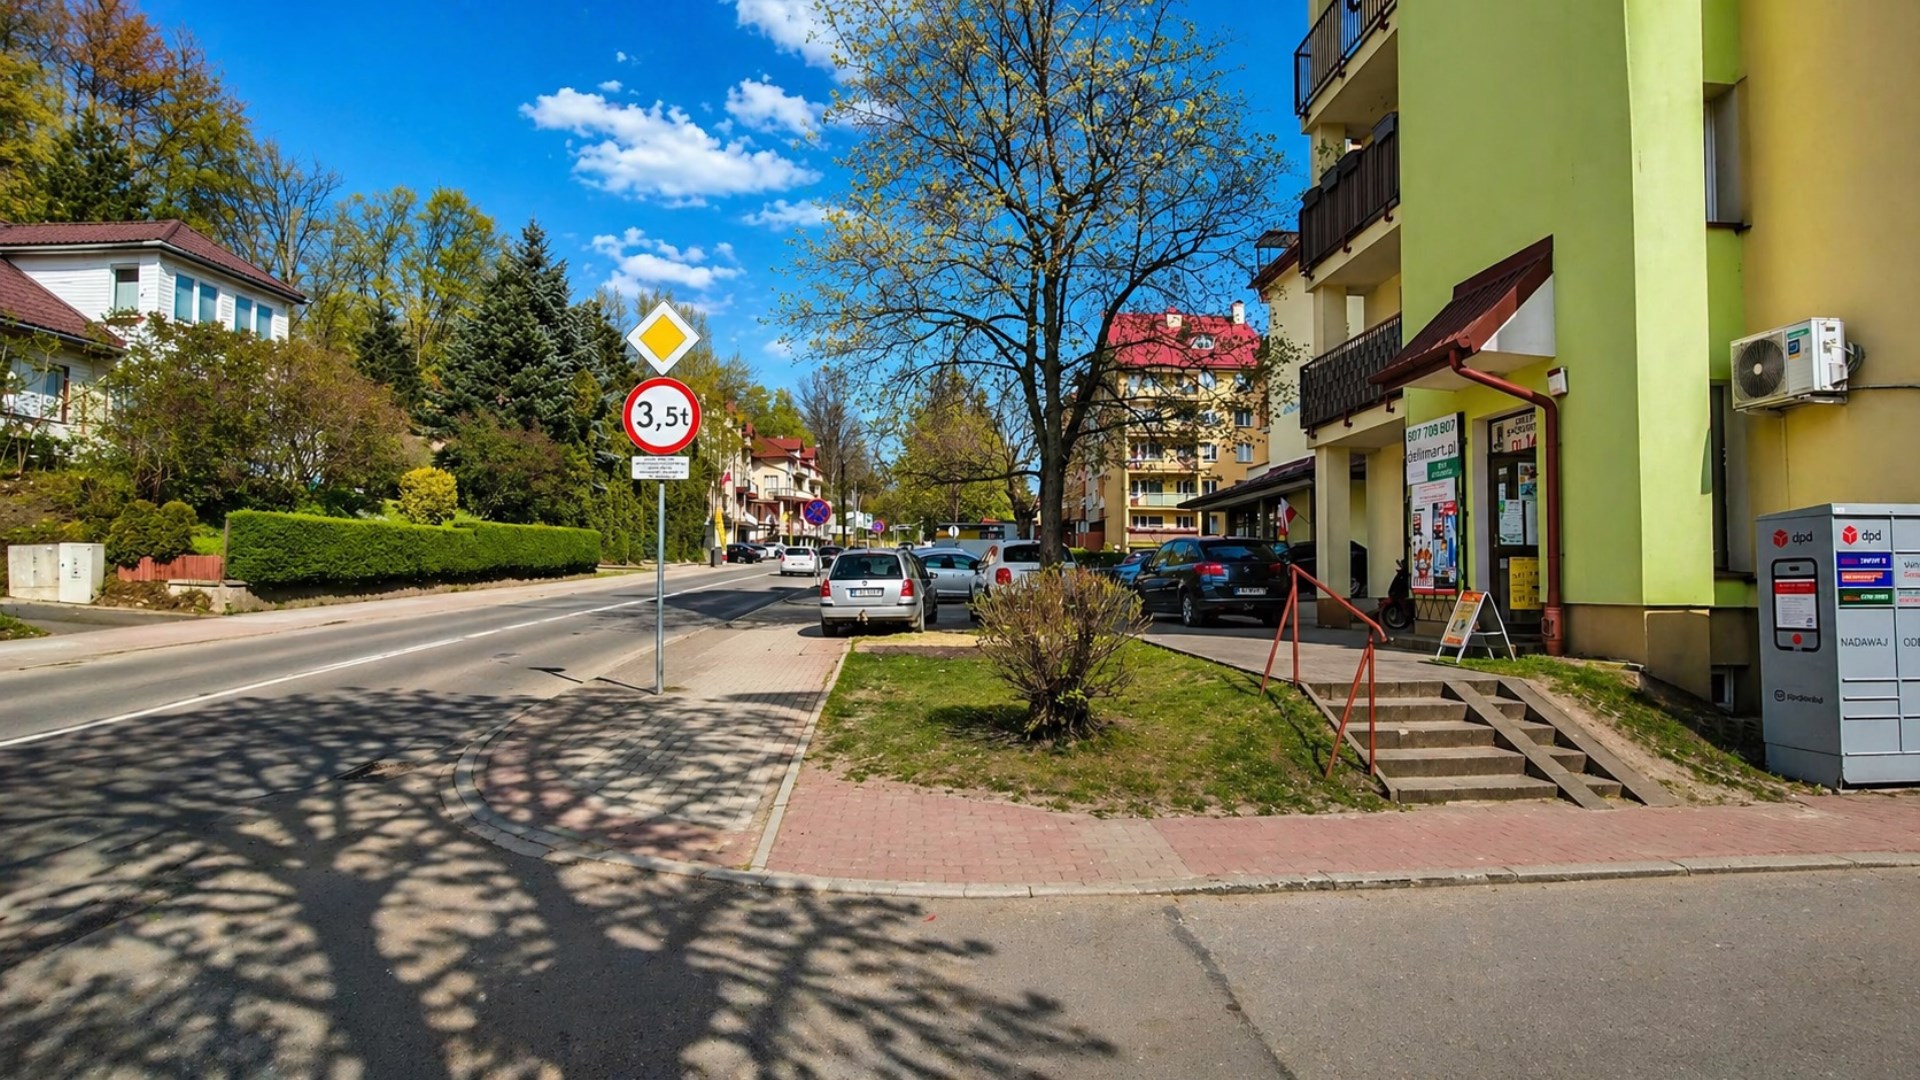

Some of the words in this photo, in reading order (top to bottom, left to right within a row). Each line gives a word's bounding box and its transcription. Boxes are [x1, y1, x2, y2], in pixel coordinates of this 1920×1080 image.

[636, 400, 689, 432] 3,5t
[1792, 531, 1813, 545] dpd
[1861, 529, 1882, 544] dpd
[1840, 637, 1888, 647] NADAWAJ
